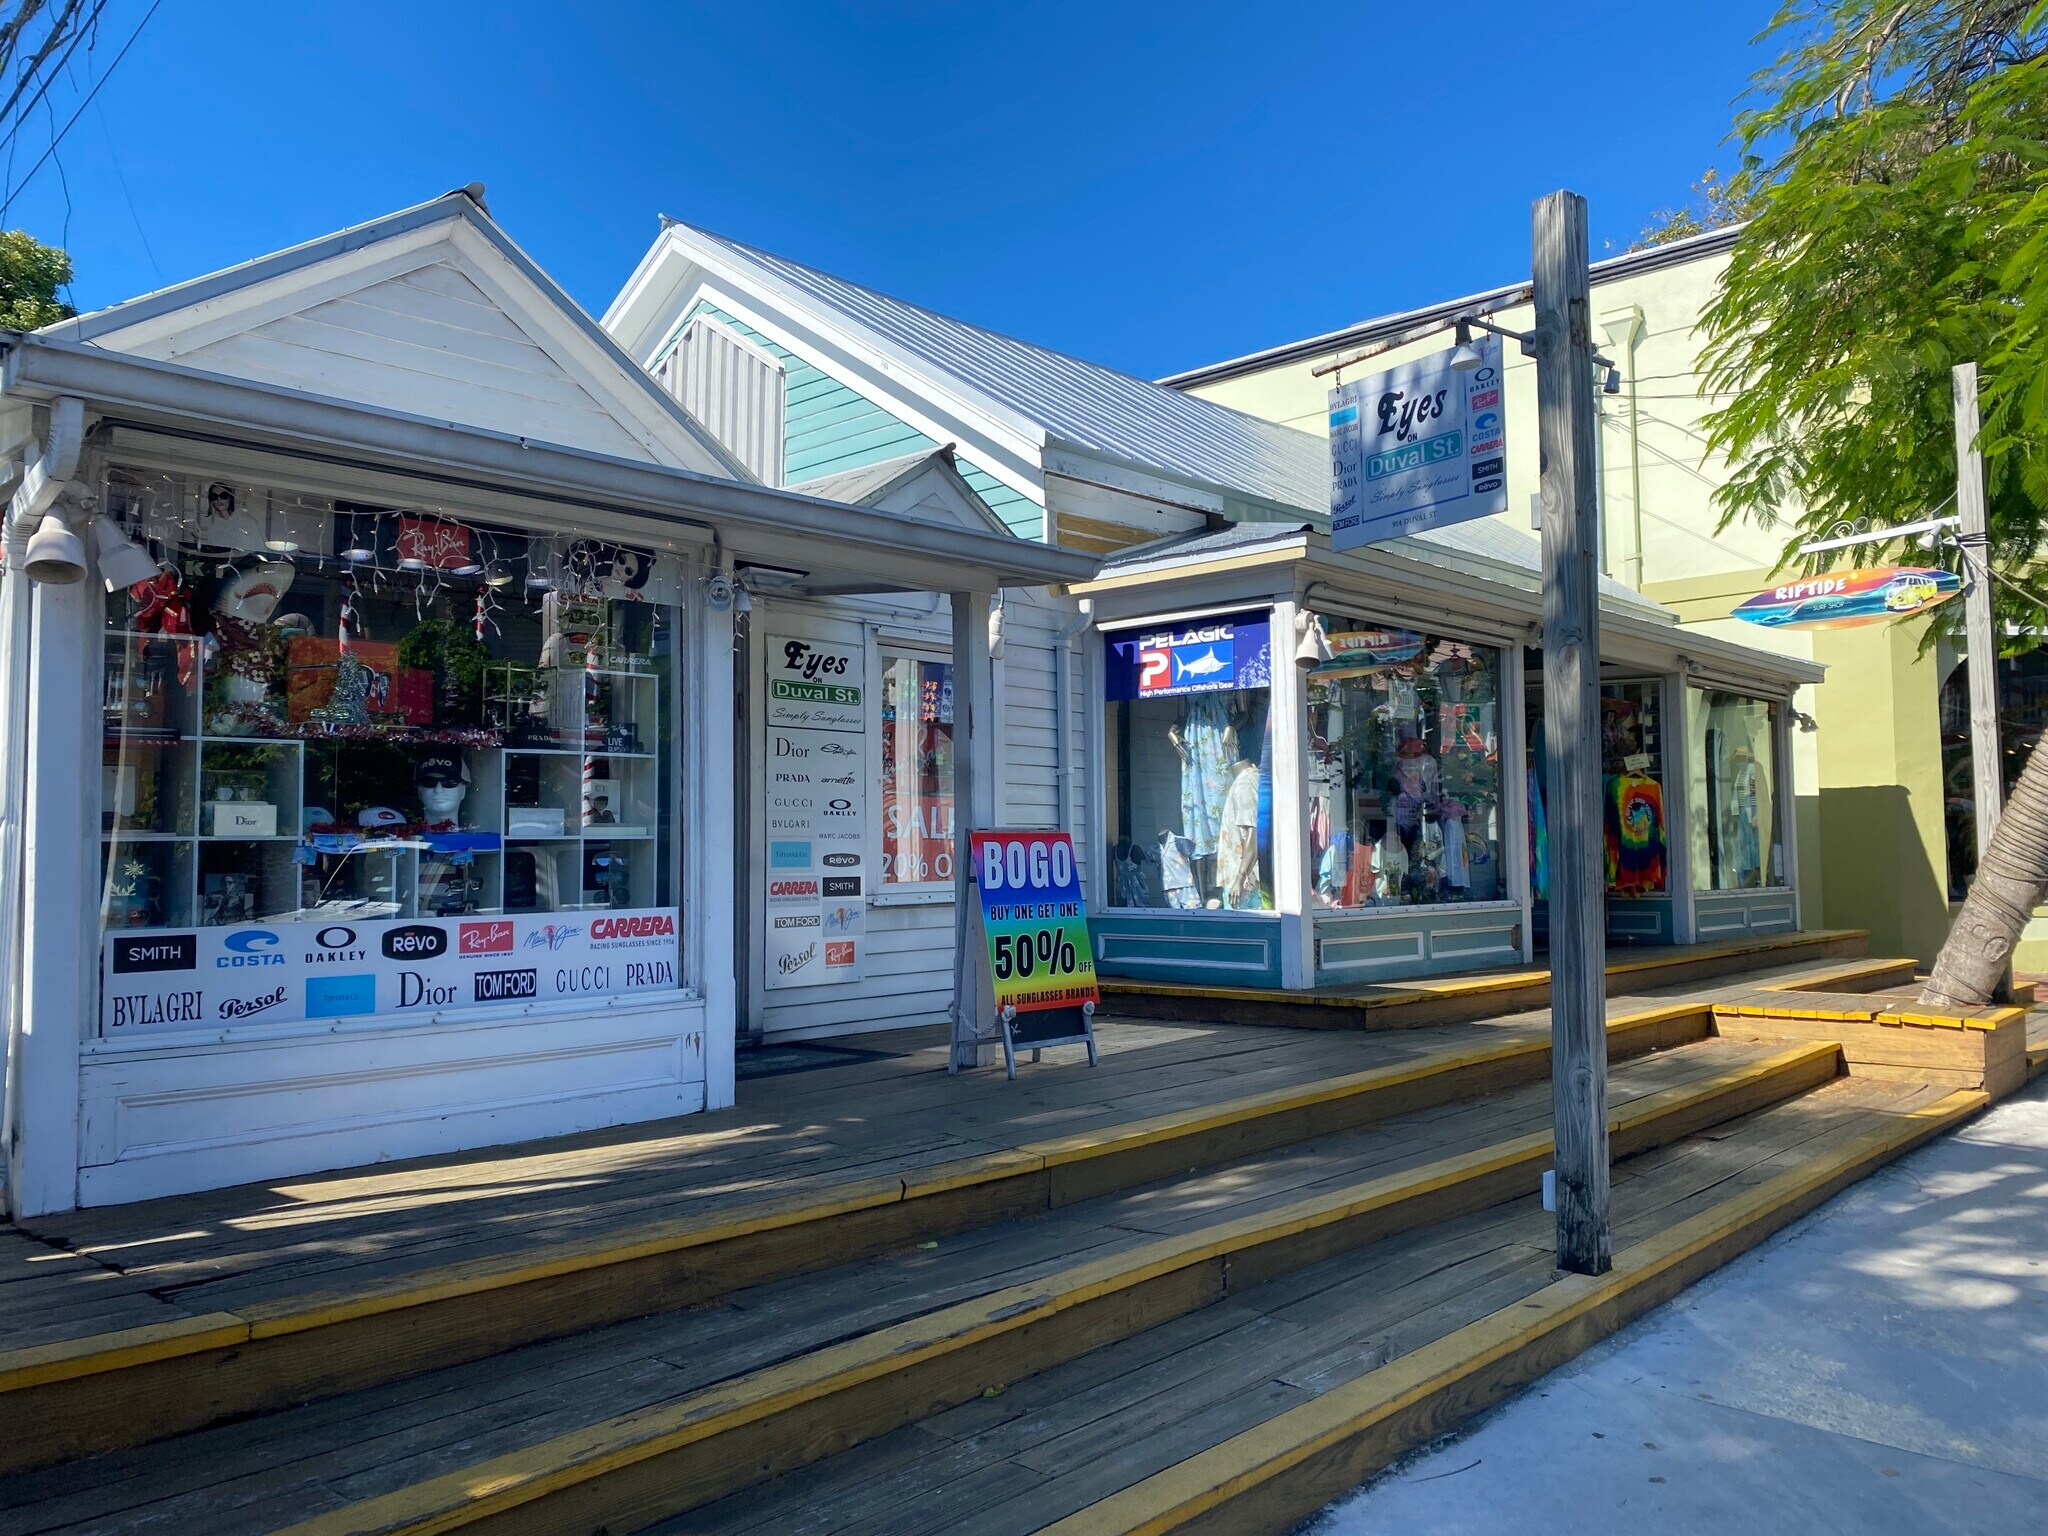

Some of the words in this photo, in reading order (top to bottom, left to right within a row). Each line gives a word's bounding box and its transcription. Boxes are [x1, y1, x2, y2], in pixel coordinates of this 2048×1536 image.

[1470, 378, 1500, 392] OAKLEY
[1377, 390, 1447, 442] Eyes
[1407, 432, 1418, 442] ON
[1472, 428, 1500, 442] COSTA
[1332, 438, 1358, 456] GUCCI
[1470, 438, 1503, 454] CARRERA
[1370, 444, 1424, 477] Duval
[1432, 438, 1460, 458] St.
[1333, 460, 1357, 476] Dior
[1478, 462, 1498, 474] SMITH
[1332, 476, 1358, 492] PRADA
[1370, 486, 1406, 504] Simply
[1408, 474, 1460, 494] Sunglasses
[1403, 514, 1427, 526] DUVAL
[402, 529, 464, 559] Ray-Ban
[1775, 578, 1848, 600] RIPTIDE
[1812, 603, 1827, 612] SURF
[1828, 602, 1844, 610] SHOP
[1139, 624, 1234, 650] PELAGIC
[784, 640, 849, 679] Eyes
[776, 682, 828, 700] Duval
[835, 688, 858, 702] St.
[1140, 690, 1154, 698] High
[1154, 686, 1190, 695] Performance
[1192, 682, 1218, 692] Offshore
[772, 708, 810, 723] Simply
[811, 710, 861, 725] Sunglasses
[528, 734, 554, 742] PRADA
[608, 738, 622, 746] LIVE
[776, 738, 810, 758] Dior
[776, 774, 810, 782] PRADA
[820, 771, 855, 784] arnette
[774, 798, 812, 807] GUCCI
[235, 816, 257, 826] Dior
[772, 820, 810, 828] BVLGARI
[883, 852, 928, 878] 20%
[982, 840, 1072, 890] BOGO
[770, 881, 818, 895] CARRERA
[830, 882, 854, 890] SMITH
[990, 904, 1010, 920] BUY
[1014, 904, 1034, 920] ONE
[1037, 903, 1055, 918] GET
[1060, 902, 1078, 918] ONE
[590, 915, 674, 939] CARRERA
[776, 918, 795, 928] TOM
[796, 917, 820, 926] FORD
[462, 923, 510, 949] Ray-Ban
[590, 942, 610, 950] RACING
[611, 940, 645, 949] SUNGLASSES
[129, 946, 181, 961] SMITH
[216, 954, 286, 968] COSTA
[305, 950, 366, 964] OAKLEY
[778, 942, 817, 975] Persol
[994, 927, 1076, 980] 50%
[626, 961, 673, 986] PRADA
[1078, 961, 1092, 973] OFF
[476, 974, 502, 998] TOM
[504, 972, 536, 996] FORD
[556, 967, 609, 993] GUCCI
[396, 971, 457, 1008] Dior
[1001, 994, 1014, 1006] ALL
[1017, 989, 1063, 1004] SUNGLASSES
[1066, 986, 1095, 999] BRANDS
[112, 991, 203, 1027] BVLAGRI
[219, 986, 288, 1020] Persol
